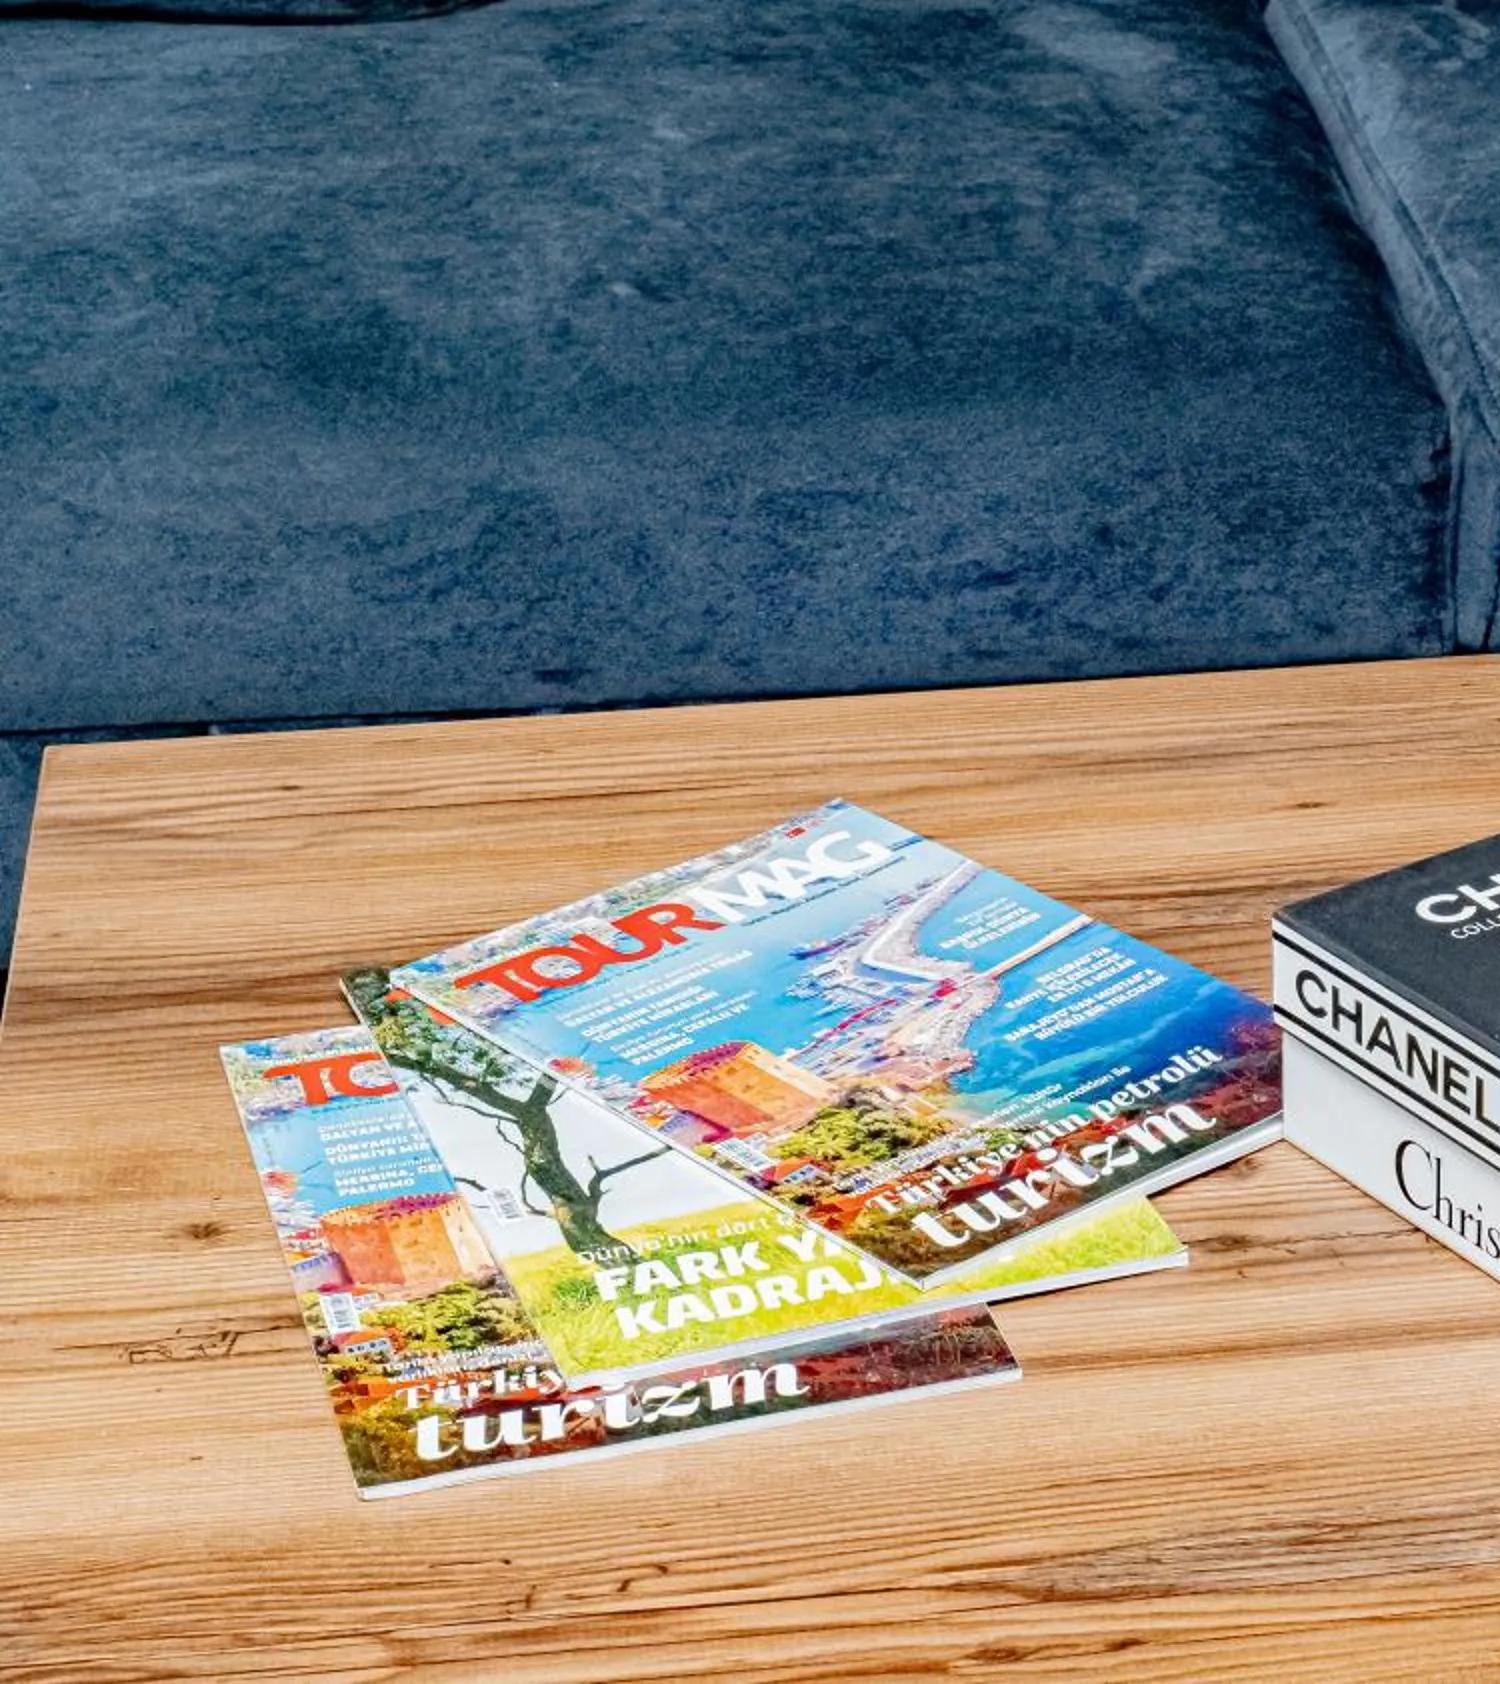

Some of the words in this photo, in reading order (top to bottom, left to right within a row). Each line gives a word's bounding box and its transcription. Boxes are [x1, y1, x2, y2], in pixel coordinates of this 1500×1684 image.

[1087, 1046, 1223, 1122] petrolü
[911, 1102, 1217, 1247] turizm
[594, 1241, 770, 1301] FARK
[613, 1260, 897, 1340] KADRAJ
[396, 1366, 564, 1409] Türkiy
[409, 1362, 810, 1460] turizm
